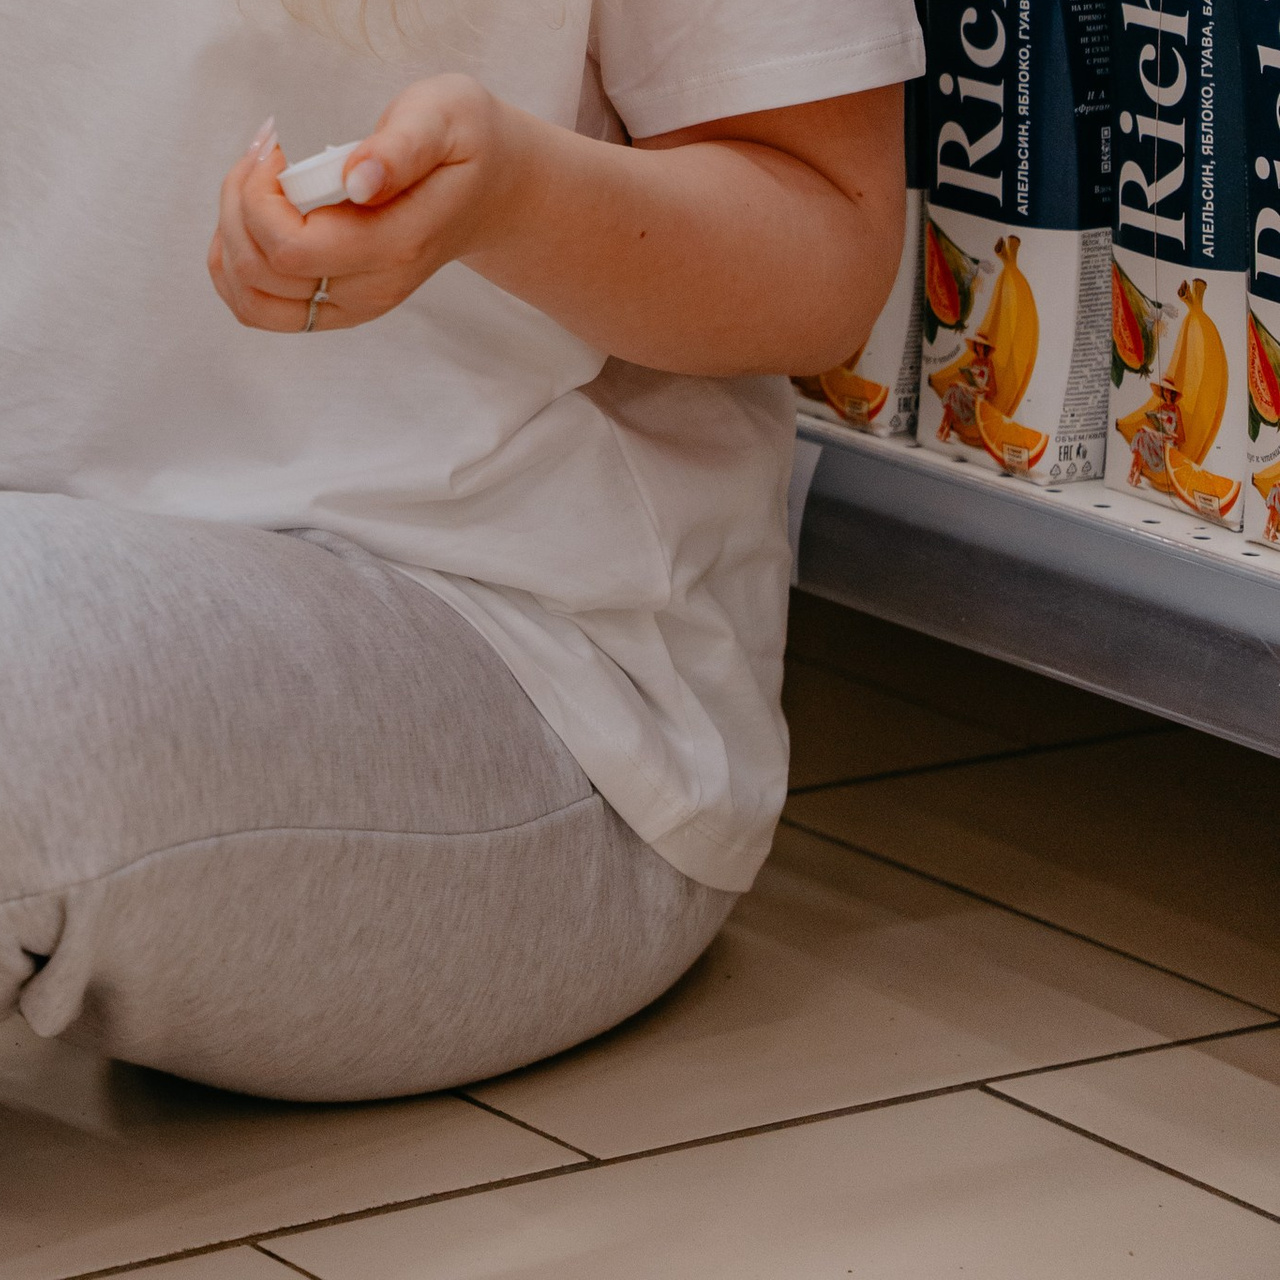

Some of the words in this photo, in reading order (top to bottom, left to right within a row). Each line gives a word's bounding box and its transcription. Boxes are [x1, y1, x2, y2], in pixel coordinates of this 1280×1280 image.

[1018, 43, 1032, 116] ЯБЛОКО,
[1201, 21, 1215, 79] ГУАВА,
[1201, 82, 1216, 156] ЯБЛОКО,
[1017, 120, 1032, 216] АПЕЛЬСИН,
[1201, 160, 1216, 259] АПЕЛЬСИН,
